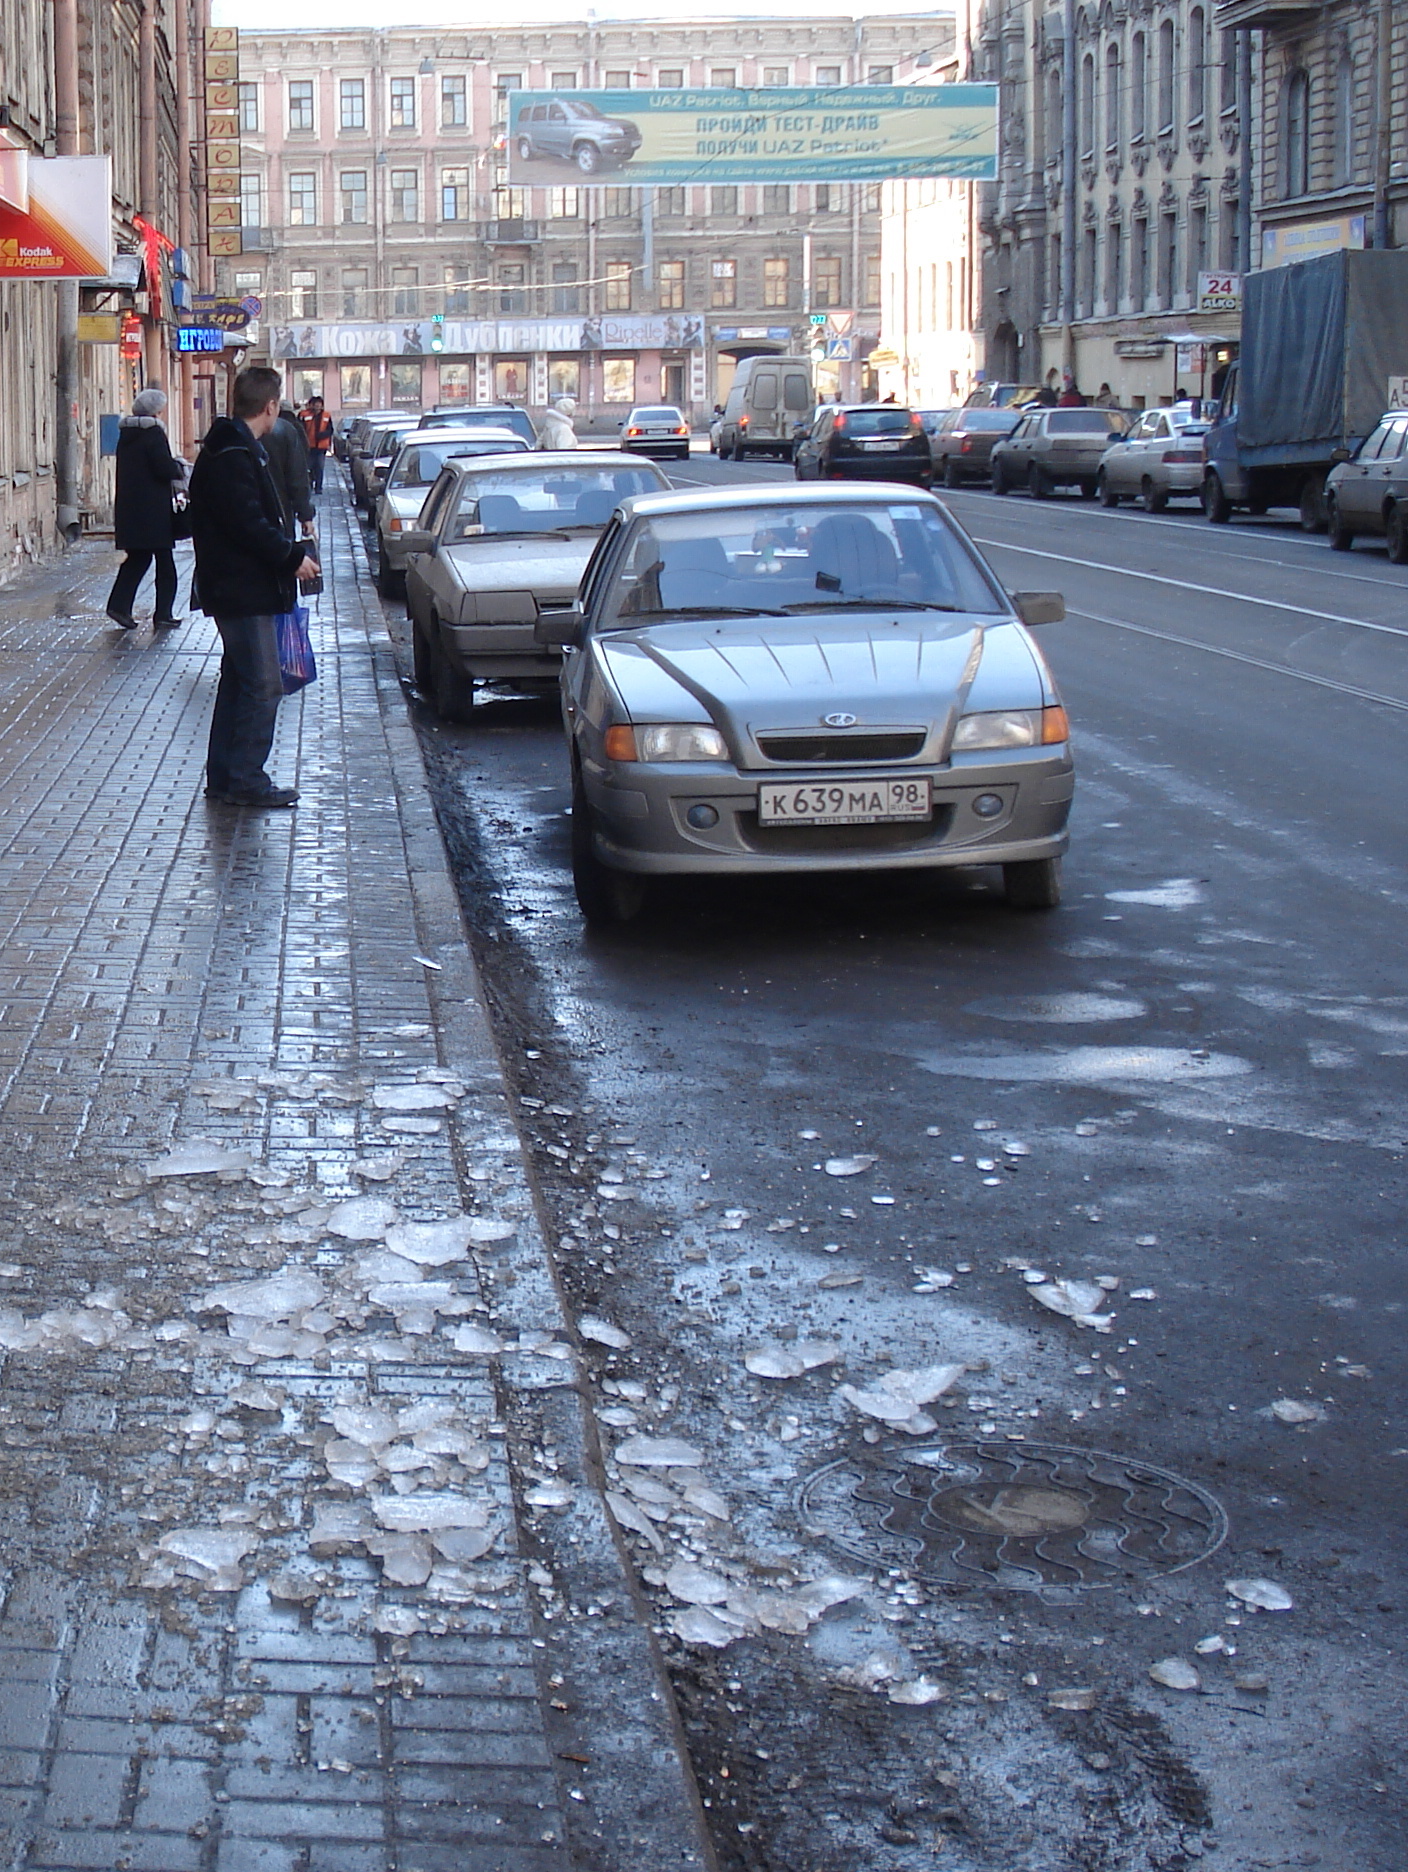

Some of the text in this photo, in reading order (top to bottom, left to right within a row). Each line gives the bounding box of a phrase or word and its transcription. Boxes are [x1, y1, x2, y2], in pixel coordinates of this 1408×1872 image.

[649, 95, 683, 107] UAZ
[902, 91, 941, 106] Друг.
[695, 114, 881, 134] ПРОЙДИ ТЕСТ-ДРАЙВ
[696, 140, 759, 155] ПОЛУЧИ
[763, 139, 805, 154] UAZ
[19, 246, 53, 257] Kodak
[5, 256, 65, 268] EXPRESS
[1208, 280, 1232, 294] 24
[1203, 298, 1236, 309] ALKO
[208, 313, 245, 331] КАФЕ
[321, 320, 581, 356] Кожа Дубленки
[892, 784, 919, 804] 98
[890, 803, 911, 812] RUS
